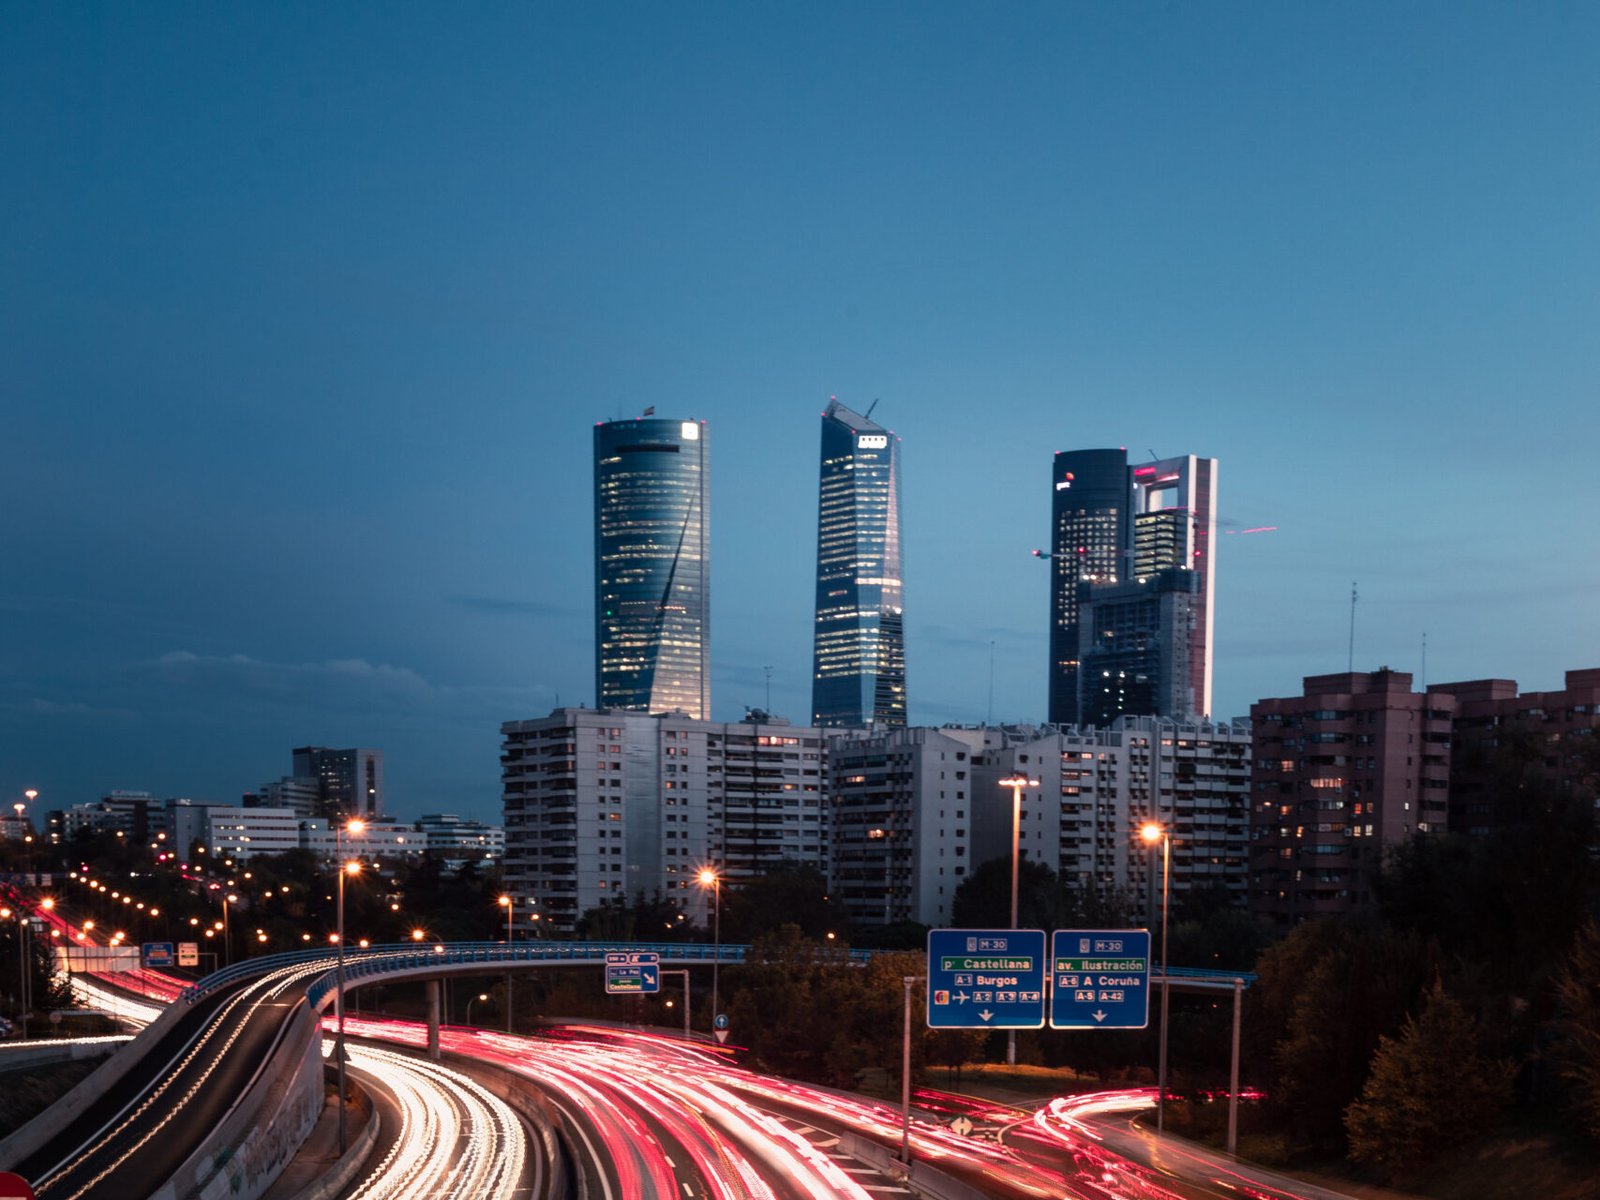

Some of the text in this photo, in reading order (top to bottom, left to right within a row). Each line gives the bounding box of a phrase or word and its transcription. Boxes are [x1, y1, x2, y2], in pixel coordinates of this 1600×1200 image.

[980, 941, 1006, 949] M-30
[1096, 942, 1121, 950] M-30
[963, 959, 1030, 969] Castellana
[1057, 960, 1143, 970] av. Ilustración
[956, 975, 1018, 988] A-1 Burgos
[1061, 976, 1141, 986] A-6 A Coruña
[975, 993, 991, 1001] A-2
[1021, 993, 1039, 1001] A-4
[1077, 992, 1122, 1000] A-5 A-42
